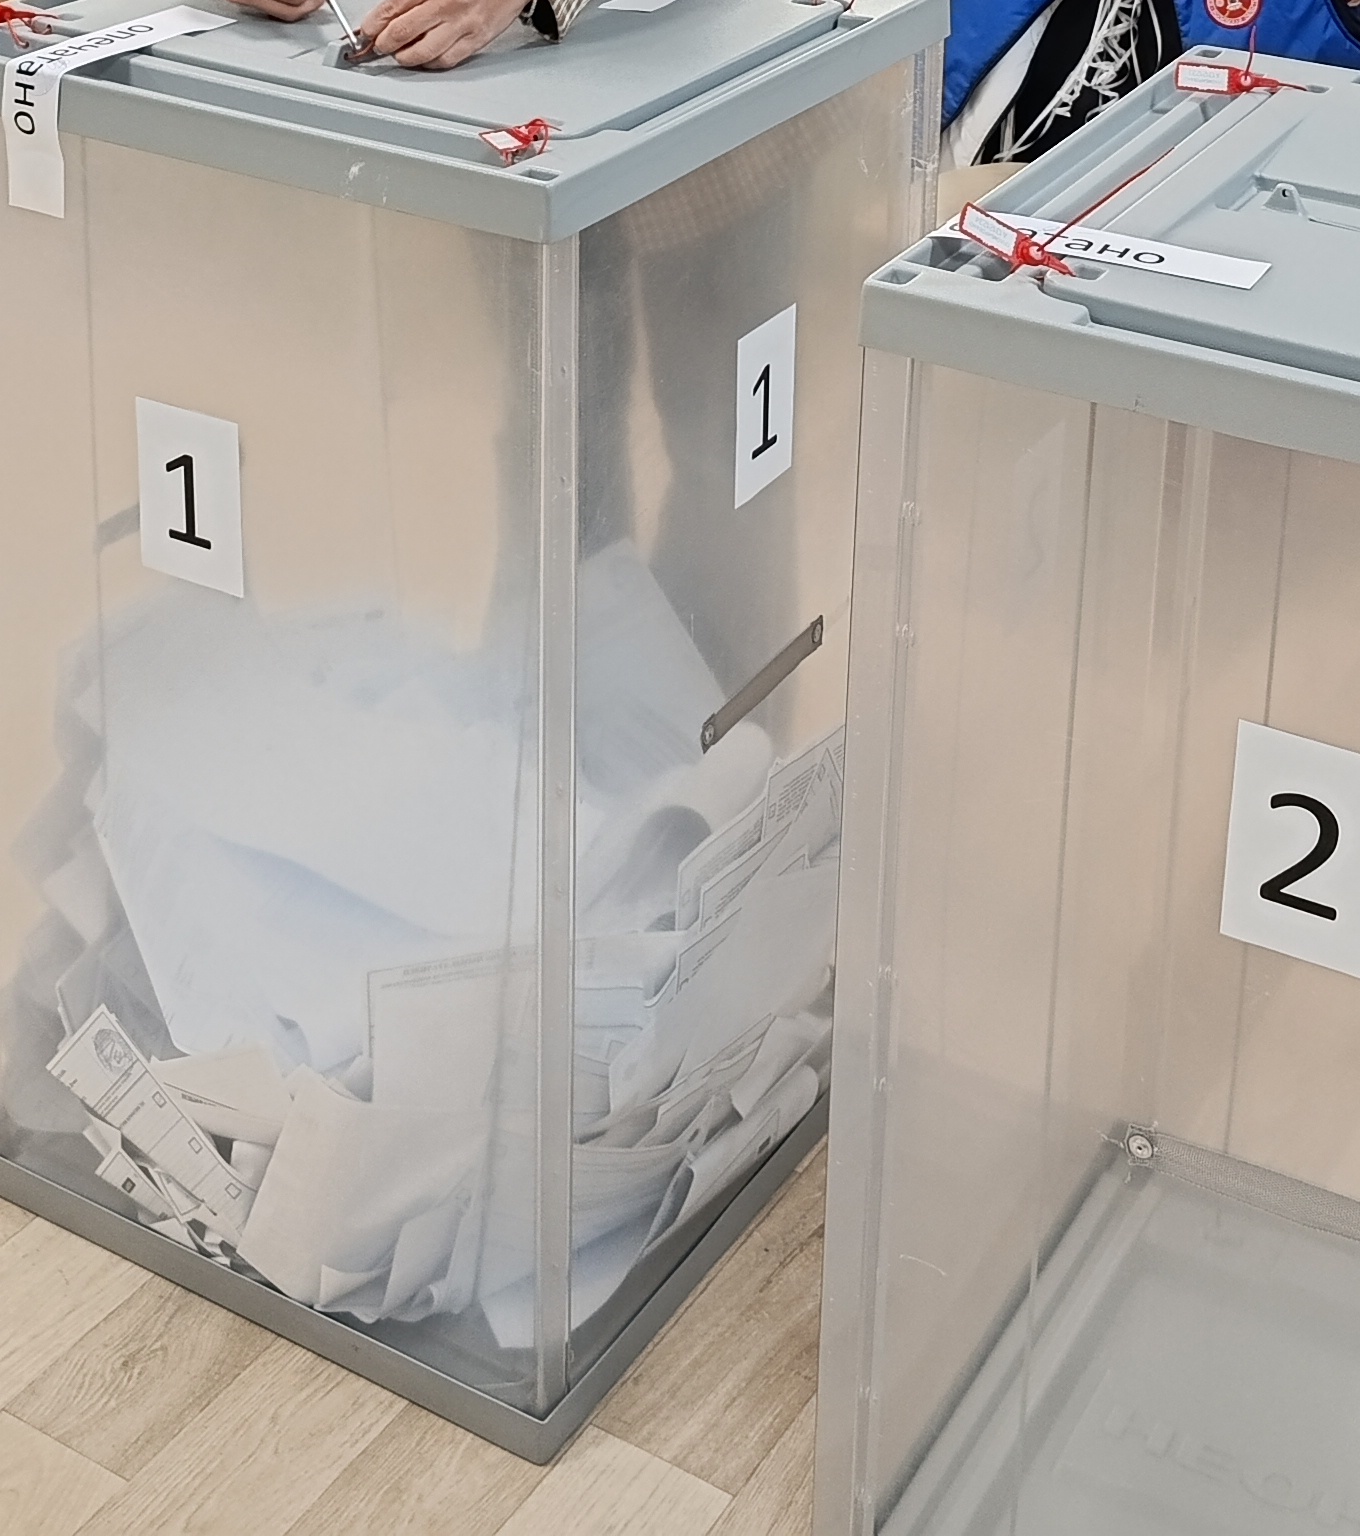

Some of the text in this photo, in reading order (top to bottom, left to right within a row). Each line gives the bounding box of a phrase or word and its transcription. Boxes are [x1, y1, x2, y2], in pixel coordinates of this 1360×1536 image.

[13, 23, 154, 136] опечатано
[750, 363, 778, 461] 1
[164, 453, 213, 551] 1
[1259, 792, 1340, 922] 2
